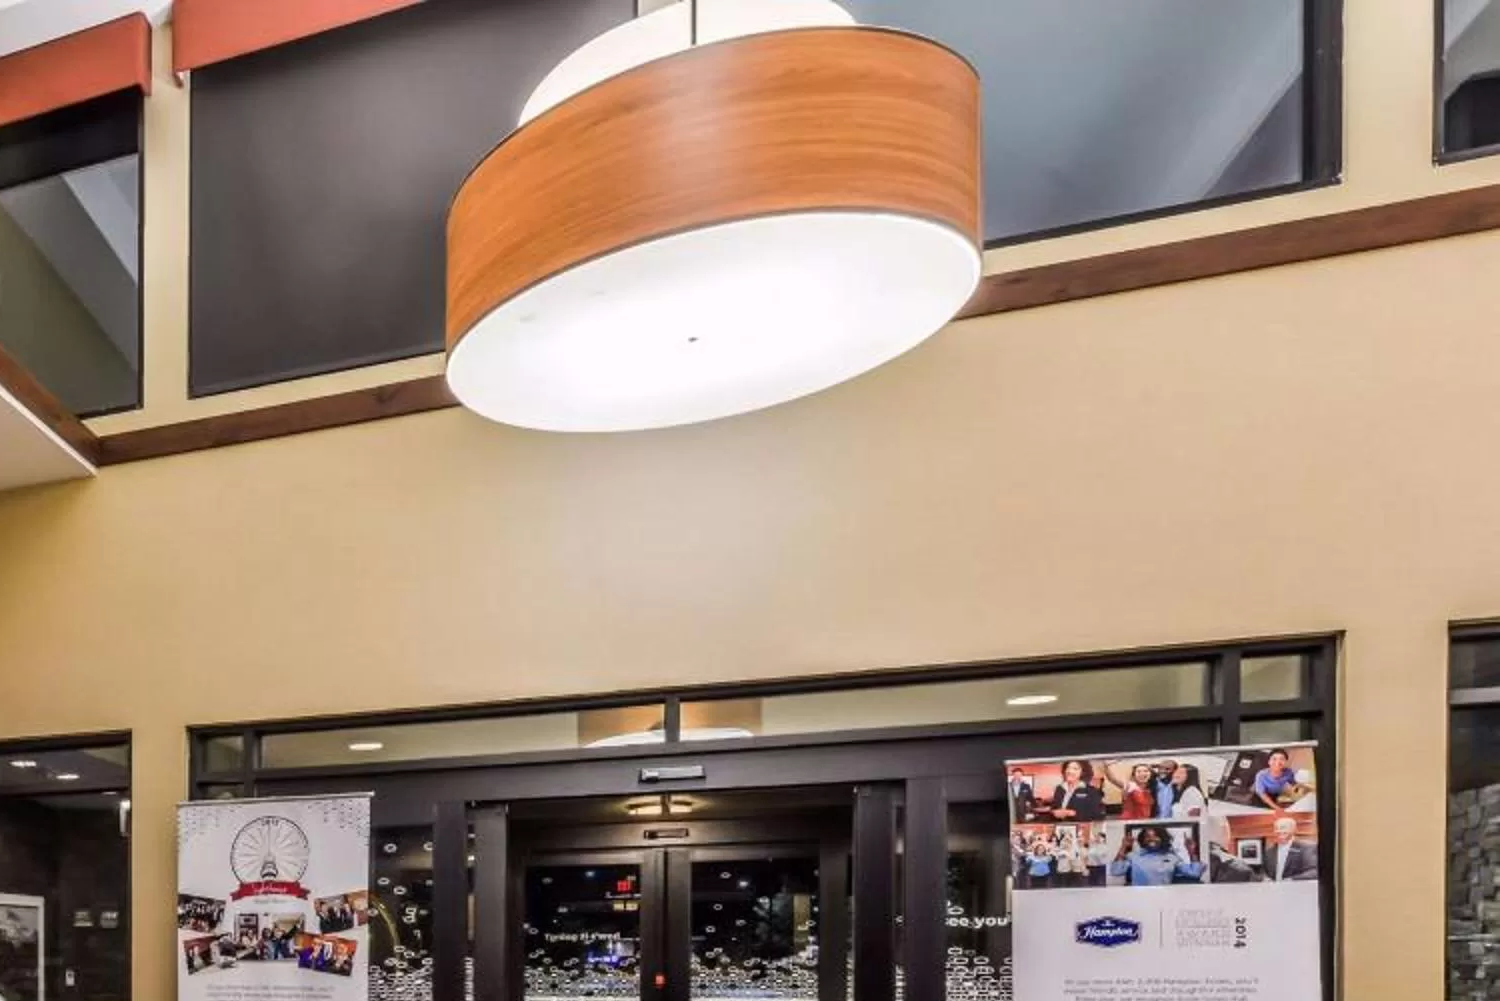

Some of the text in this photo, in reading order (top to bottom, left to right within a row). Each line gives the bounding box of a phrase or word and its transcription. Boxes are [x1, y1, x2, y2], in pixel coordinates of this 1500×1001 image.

[973, 917, 1009, 929] you
[1083, 926, 1134, 938] Hampton
[1233, 916, 1247, 948] 2014
